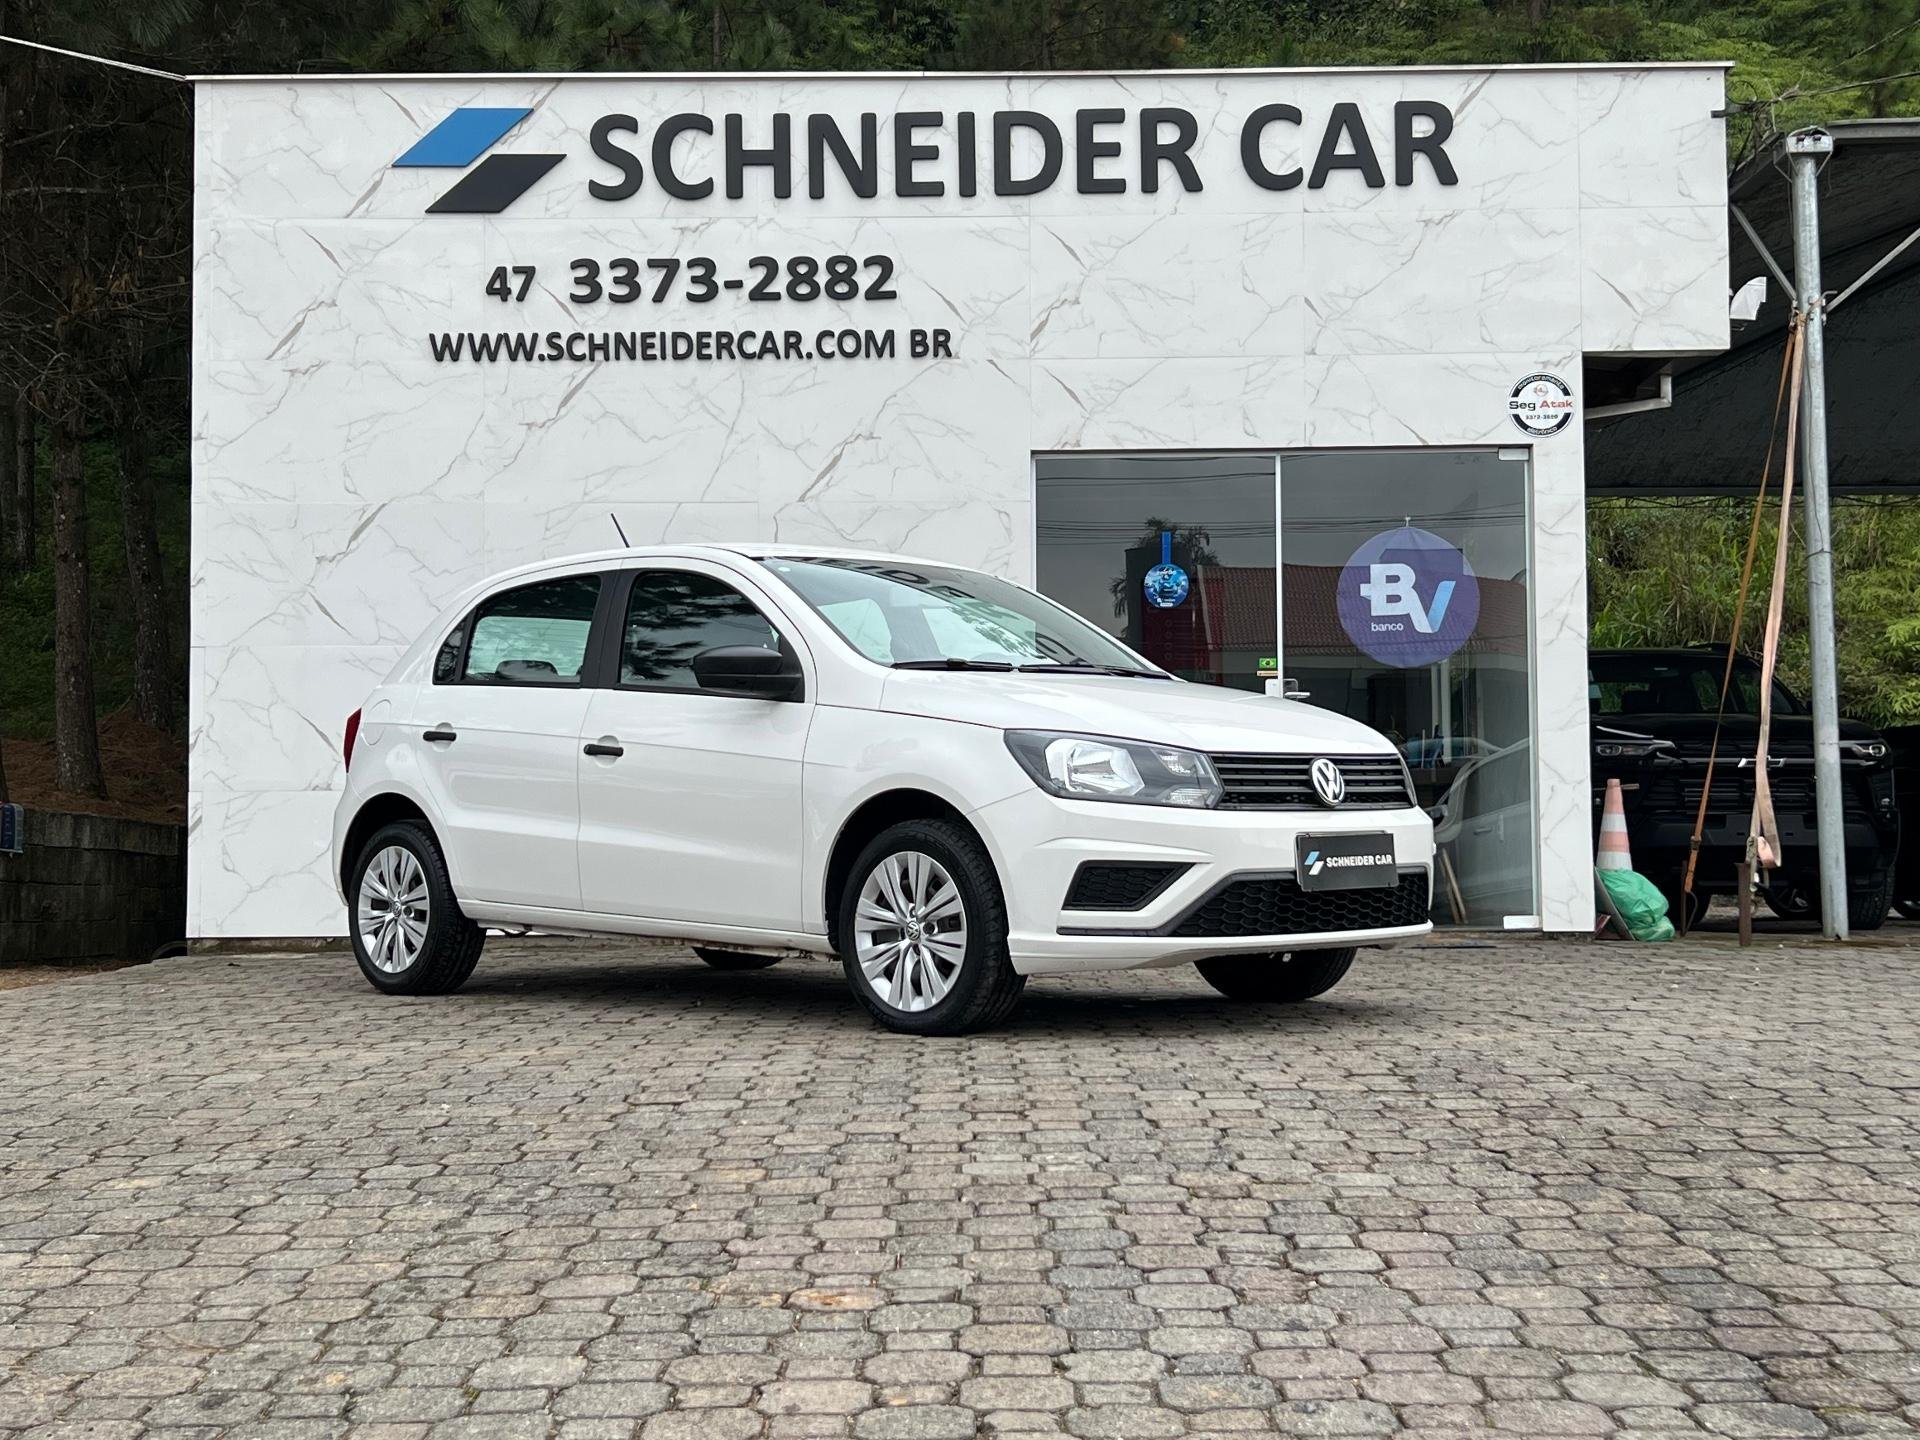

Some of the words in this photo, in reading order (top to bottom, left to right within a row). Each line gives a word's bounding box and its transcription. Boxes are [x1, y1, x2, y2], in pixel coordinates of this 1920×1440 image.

[588, 107, 1204, 202] SCHNEIDER
[1240, 100, 1459, 192] CAR
[486, 265, 536, 303] 47
[569, 254, 898, 305] 3373-2882
[428, 329, 895, 363] WWW.SCHNEIDERCAR.COM
[910, 328, 953, 359] BR
[1509, 401, 1536, 411] Seg
[1540, 400, 1573, 409] Atak
[1371, 622, 1404, 632] banco
[1326, 855, 1375, 868] SCHNEIDER
[1375, 854, 1393, 865] CAR
